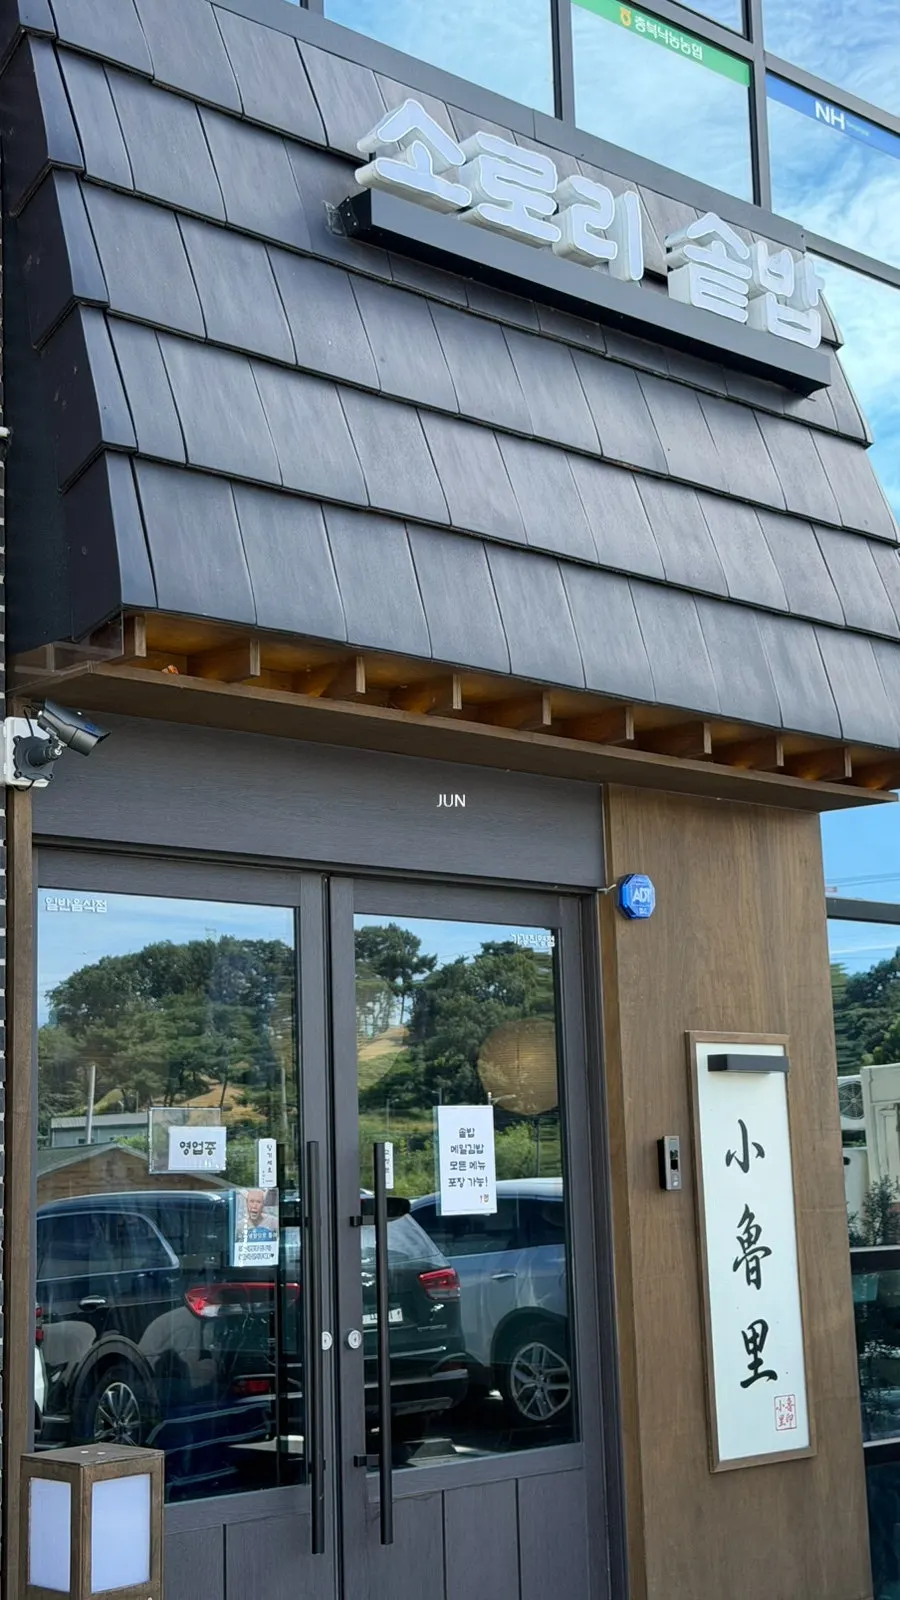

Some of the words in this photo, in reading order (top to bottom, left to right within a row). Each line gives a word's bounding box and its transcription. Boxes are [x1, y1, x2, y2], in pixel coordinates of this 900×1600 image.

[814, 100, 846, 131] NH
[356, 98, 645, 281] 소로리
[665, 211, 826, 350] 솥밥
[45, 896, 108, 913] 일반음식점
[458, 1127, 476, 1139] 솥밥
[179, 1140, 217, 1156] 영업중
[449, 1160, 467, 1171] 모든
[469, 1160, 486, 1171] 메뉴
[448, 1177, 465, 1189] 포장
[467, 1176, 488, 1188] 가능!
[725, 1118, 778, 1390] 小魯里
